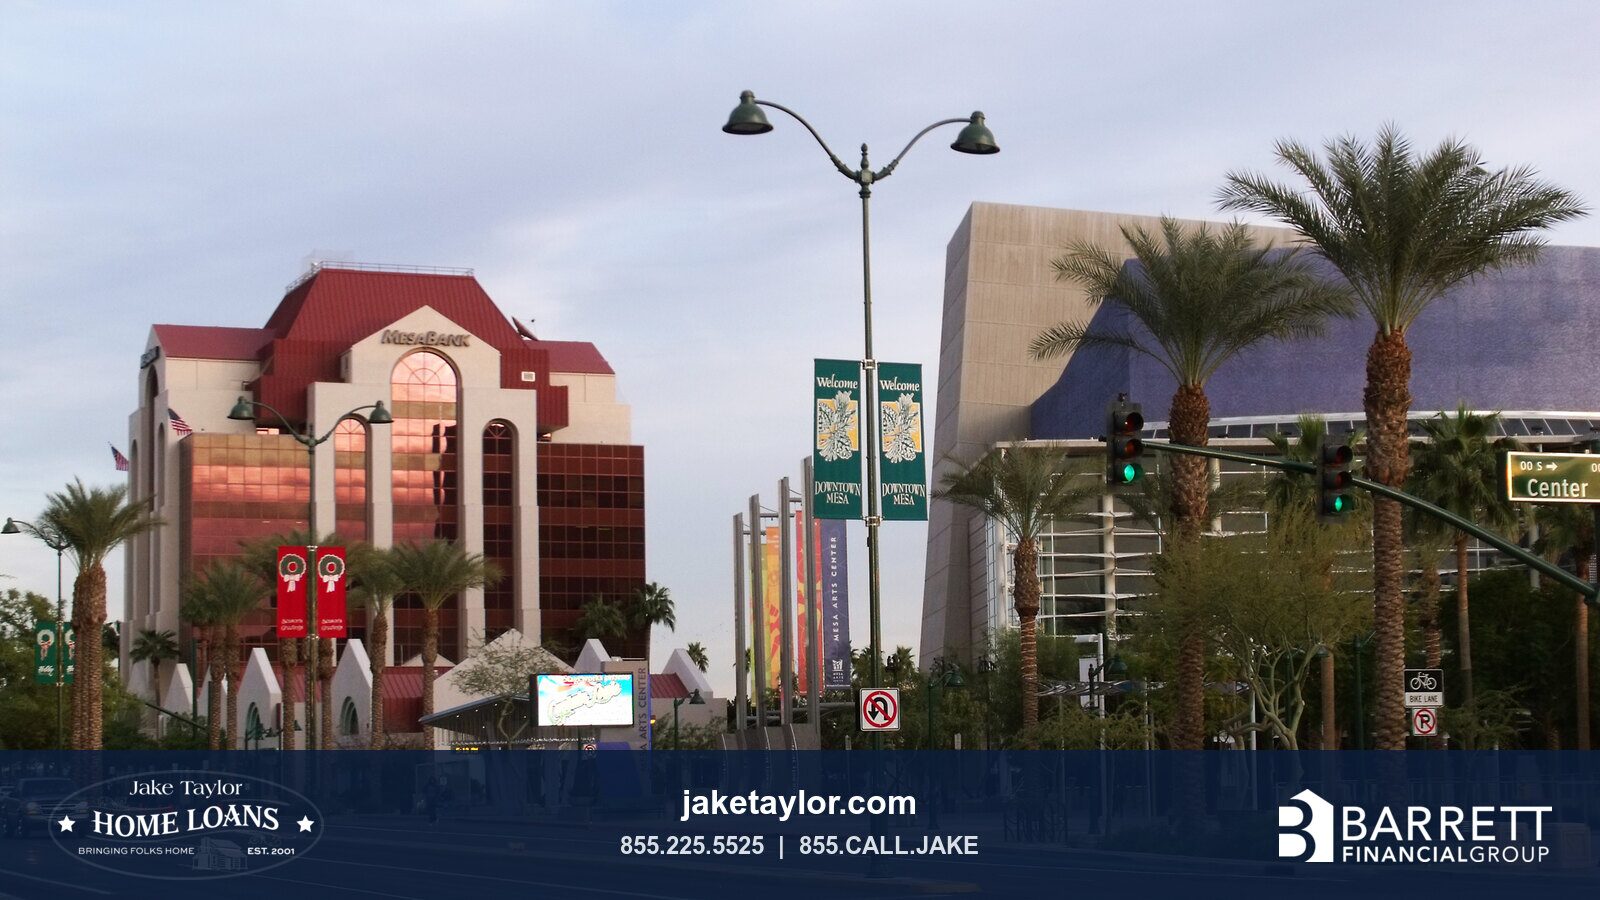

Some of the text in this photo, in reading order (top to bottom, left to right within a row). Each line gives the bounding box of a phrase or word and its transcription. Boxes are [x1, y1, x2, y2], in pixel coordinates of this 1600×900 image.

[816, 373, 859, 389] Welcome
[880, 376, 920, 391] Welcome
[1537, 461, 1543, 471] S
[815, 481, 861, 496] DOWNTOWN
[882, 483, 926, 498] DOWNTOWN
[1527, 478, 1589, 497] Center
[826, 492, 849, 505] MESA
[893, 493, 915, 505] MESA
[638, 667, 647, 708] CENTER
[1410, 695, 1438, 703] BIKE LANE
[639, 713, 647, 740] ARTS
